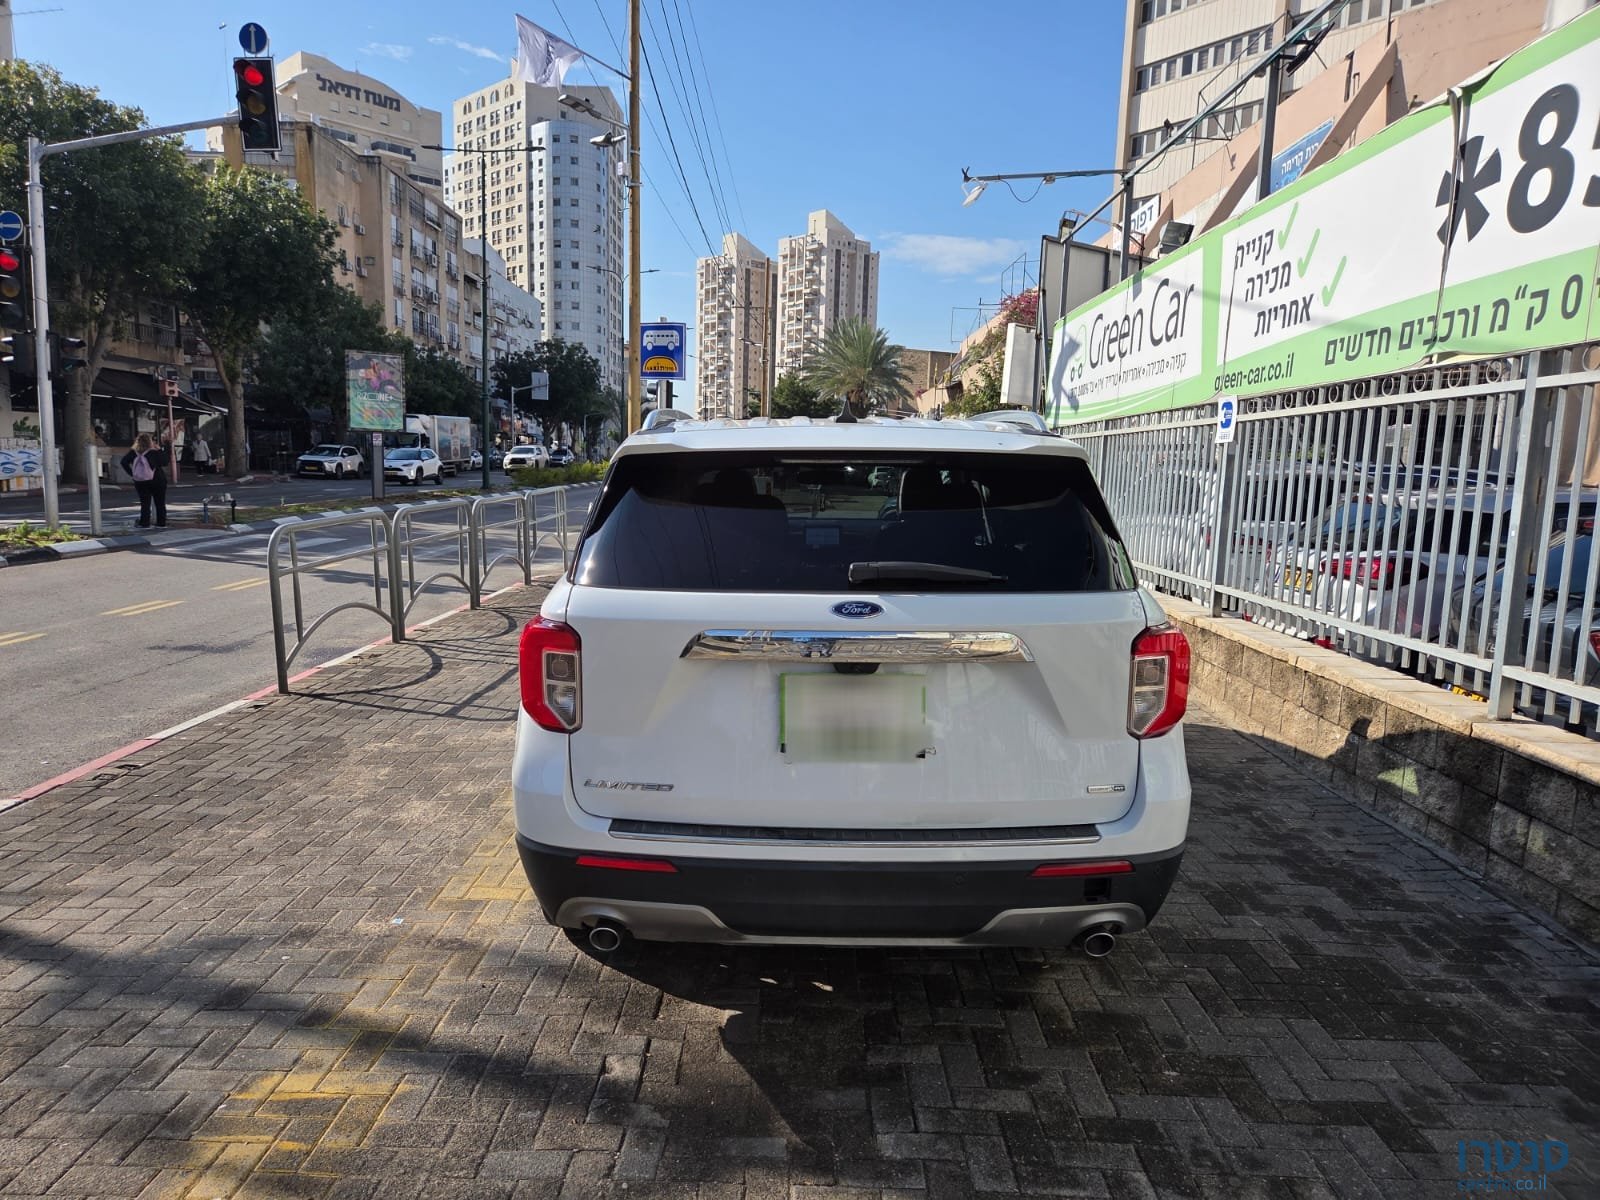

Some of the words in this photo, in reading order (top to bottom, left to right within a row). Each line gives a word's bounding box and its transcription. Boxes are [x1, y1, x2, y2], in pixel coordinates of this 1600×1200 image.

[1245, 260, 1292, 303] מכירה
[1560, 273, 1584, 320] 0
[1089, 308, 1144, 369] Green
[1150, 278, 1195, 347] Car
[1254, 293, 1315, 337] אחריות
[1398, 304, 1481, 351] ורכבים
[1325, 326, 1392, 366] חדשים
[841, 603, 872, 614] Ford
[583, 778, 675, 792] LIMITED
